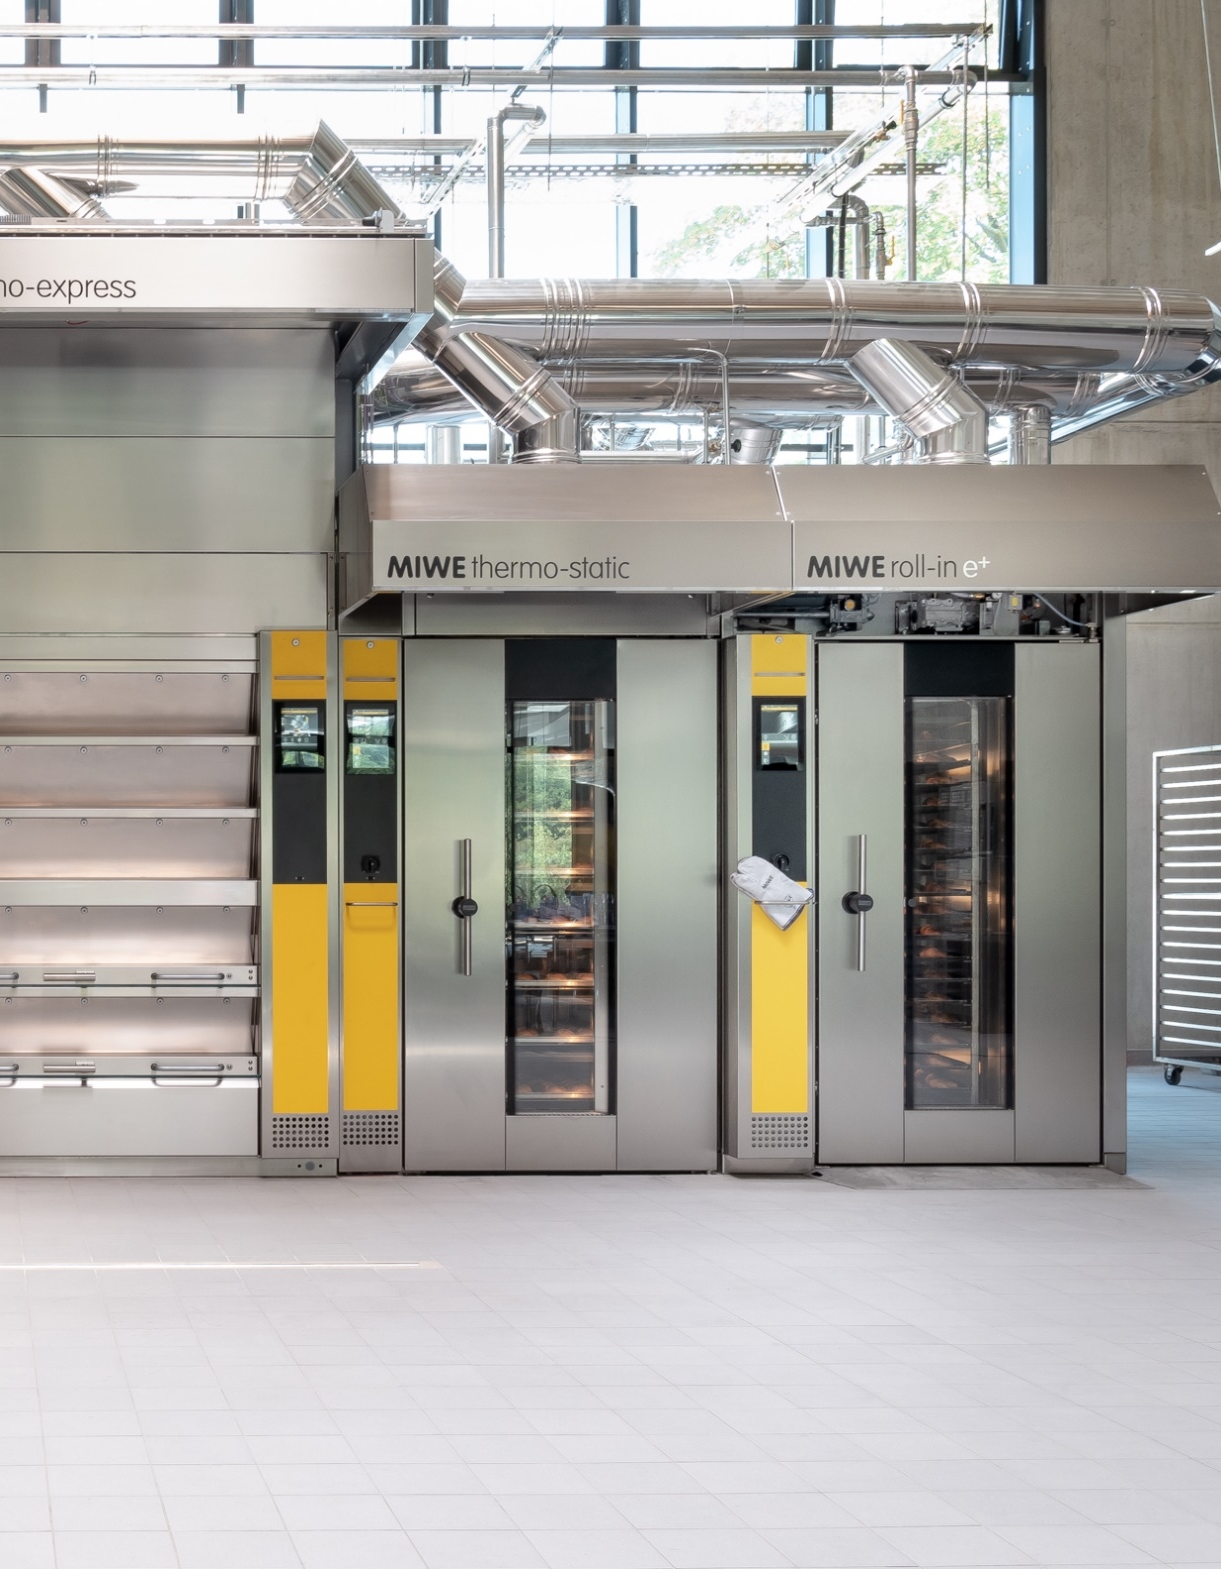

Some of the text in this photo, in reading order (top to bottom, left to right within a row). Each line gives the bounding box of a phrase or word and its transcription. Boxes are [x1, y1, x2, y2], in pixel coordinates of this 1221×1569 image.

[387, 554, 630, 579] MIWE thermo-static
[807, 555, 885, 578] MIWE
[891, 553, 957, 578] roll-in
